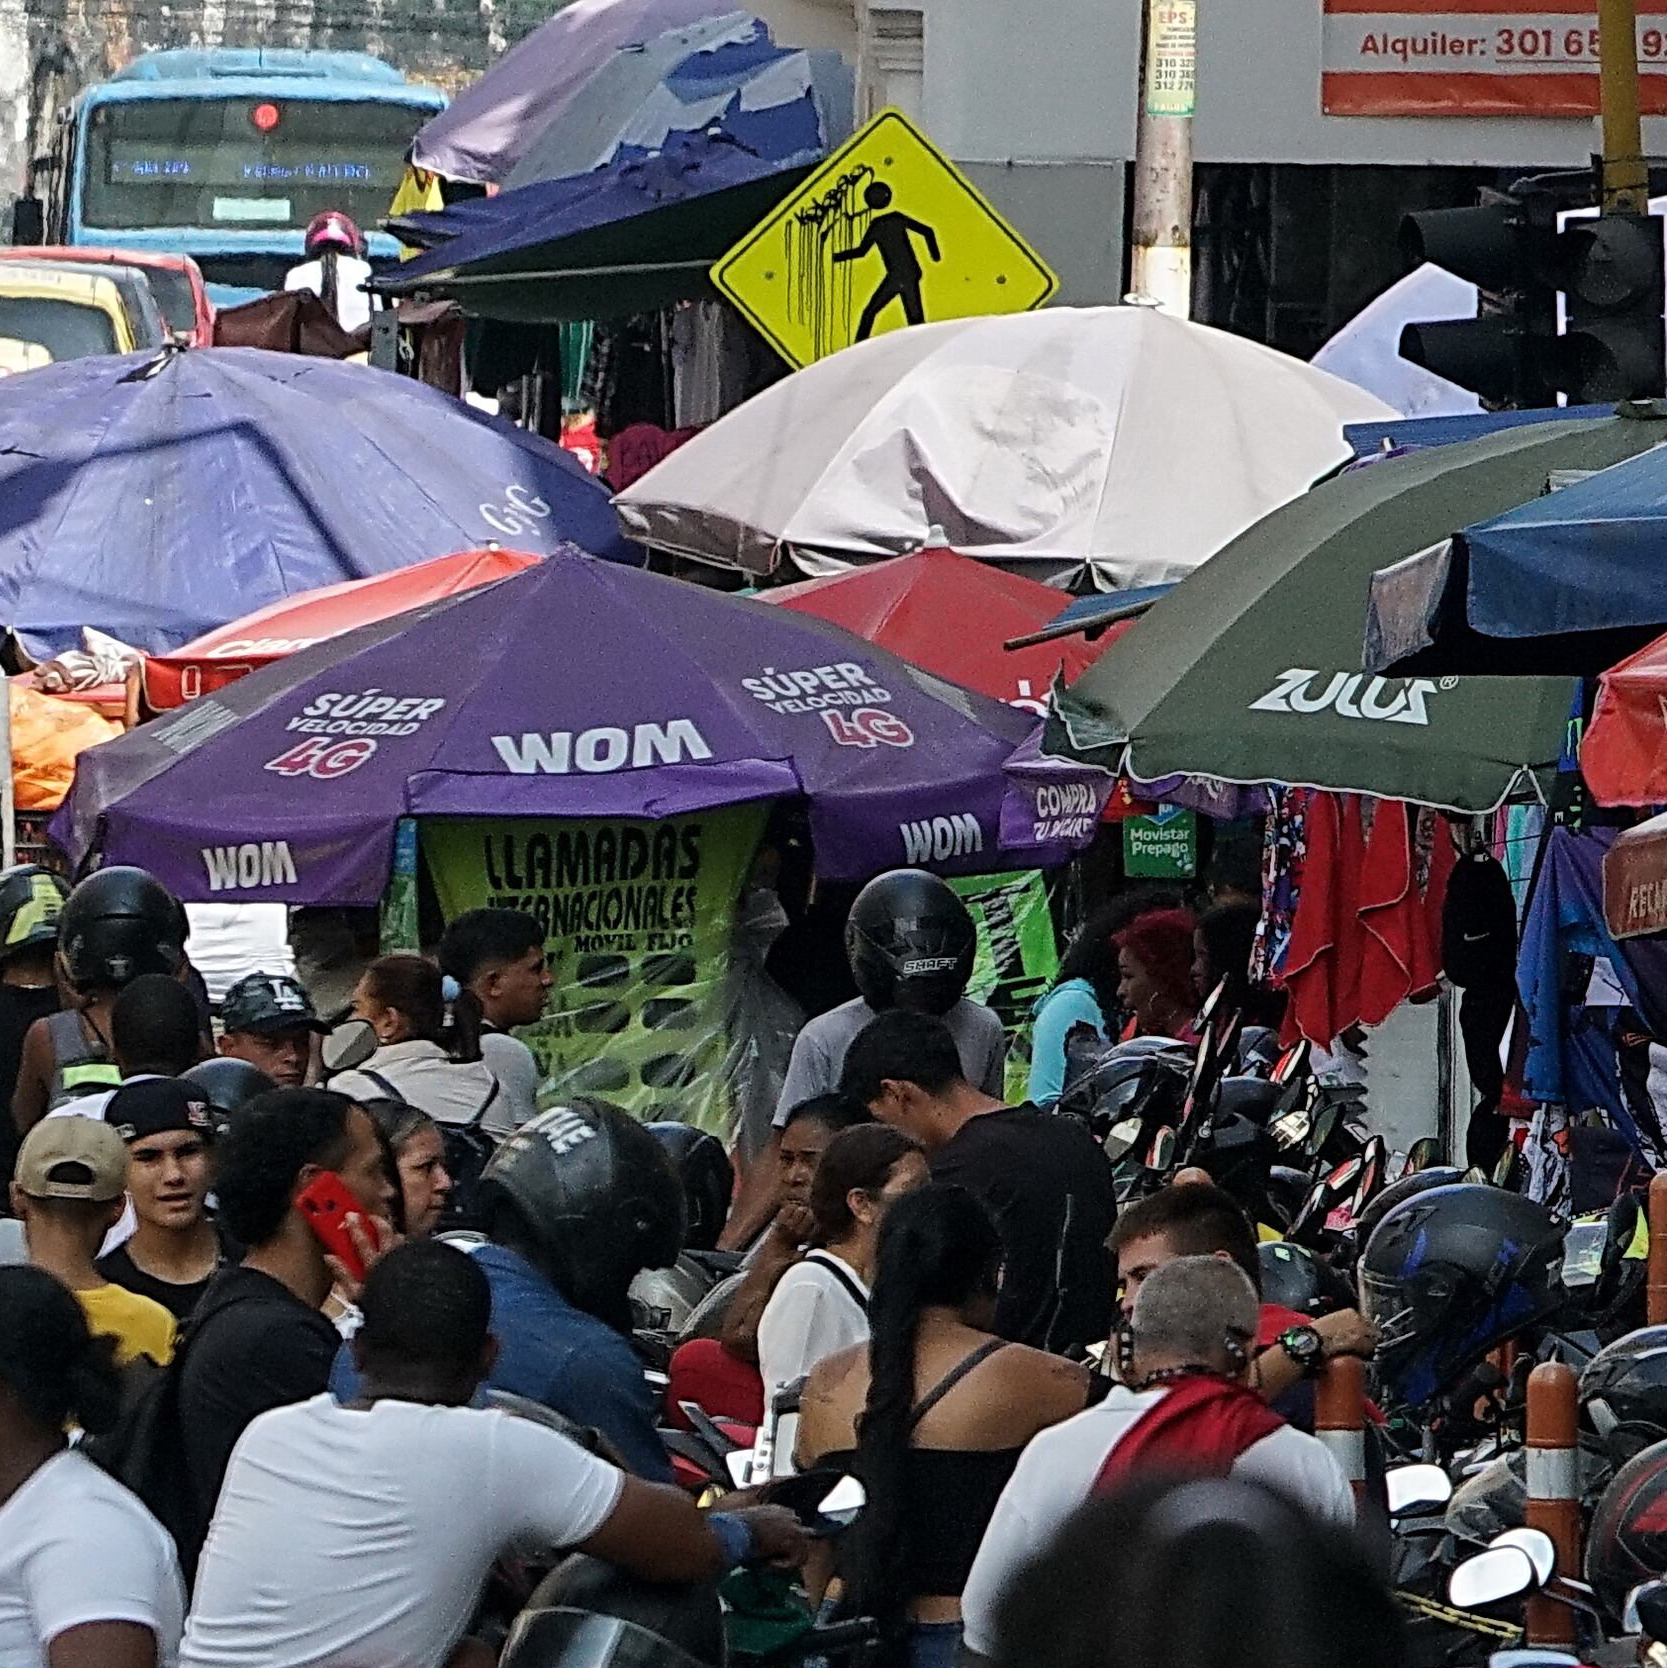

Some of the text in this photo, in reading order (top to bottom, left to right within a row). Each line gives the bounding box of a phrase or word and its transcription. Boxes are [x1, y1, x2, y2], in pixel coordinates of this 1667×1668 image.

[1360, 30, 1486, 62] Alquiler:
[1496, 29, 1553, 57] 301
[742, 662, 876, 702] SÚPER
[303, 688, 446, 721] SÚPER
[765, 687, 892, 715] VELOCIDAD
[285, 717, 421, 736] VELOCIDAD
[819, 708, 915, 748] 4G
[263, 737, 378, 780] 4G
[492, 719, 713, 775] WOM
[1036, 783, 1097, 818] COMPRA
[900, 813, 983, 865] WOM
[1130, 827, 1190, 842] Movistar
[1131, 841, 1189, 857] Prepago
[202, 840, 298, 891] WOM
[483, 823, 702, 890] LLAMADAS
[487, 884, 698, 937] RNACIONALES
[903, 957, 957, 974] SHAFT
